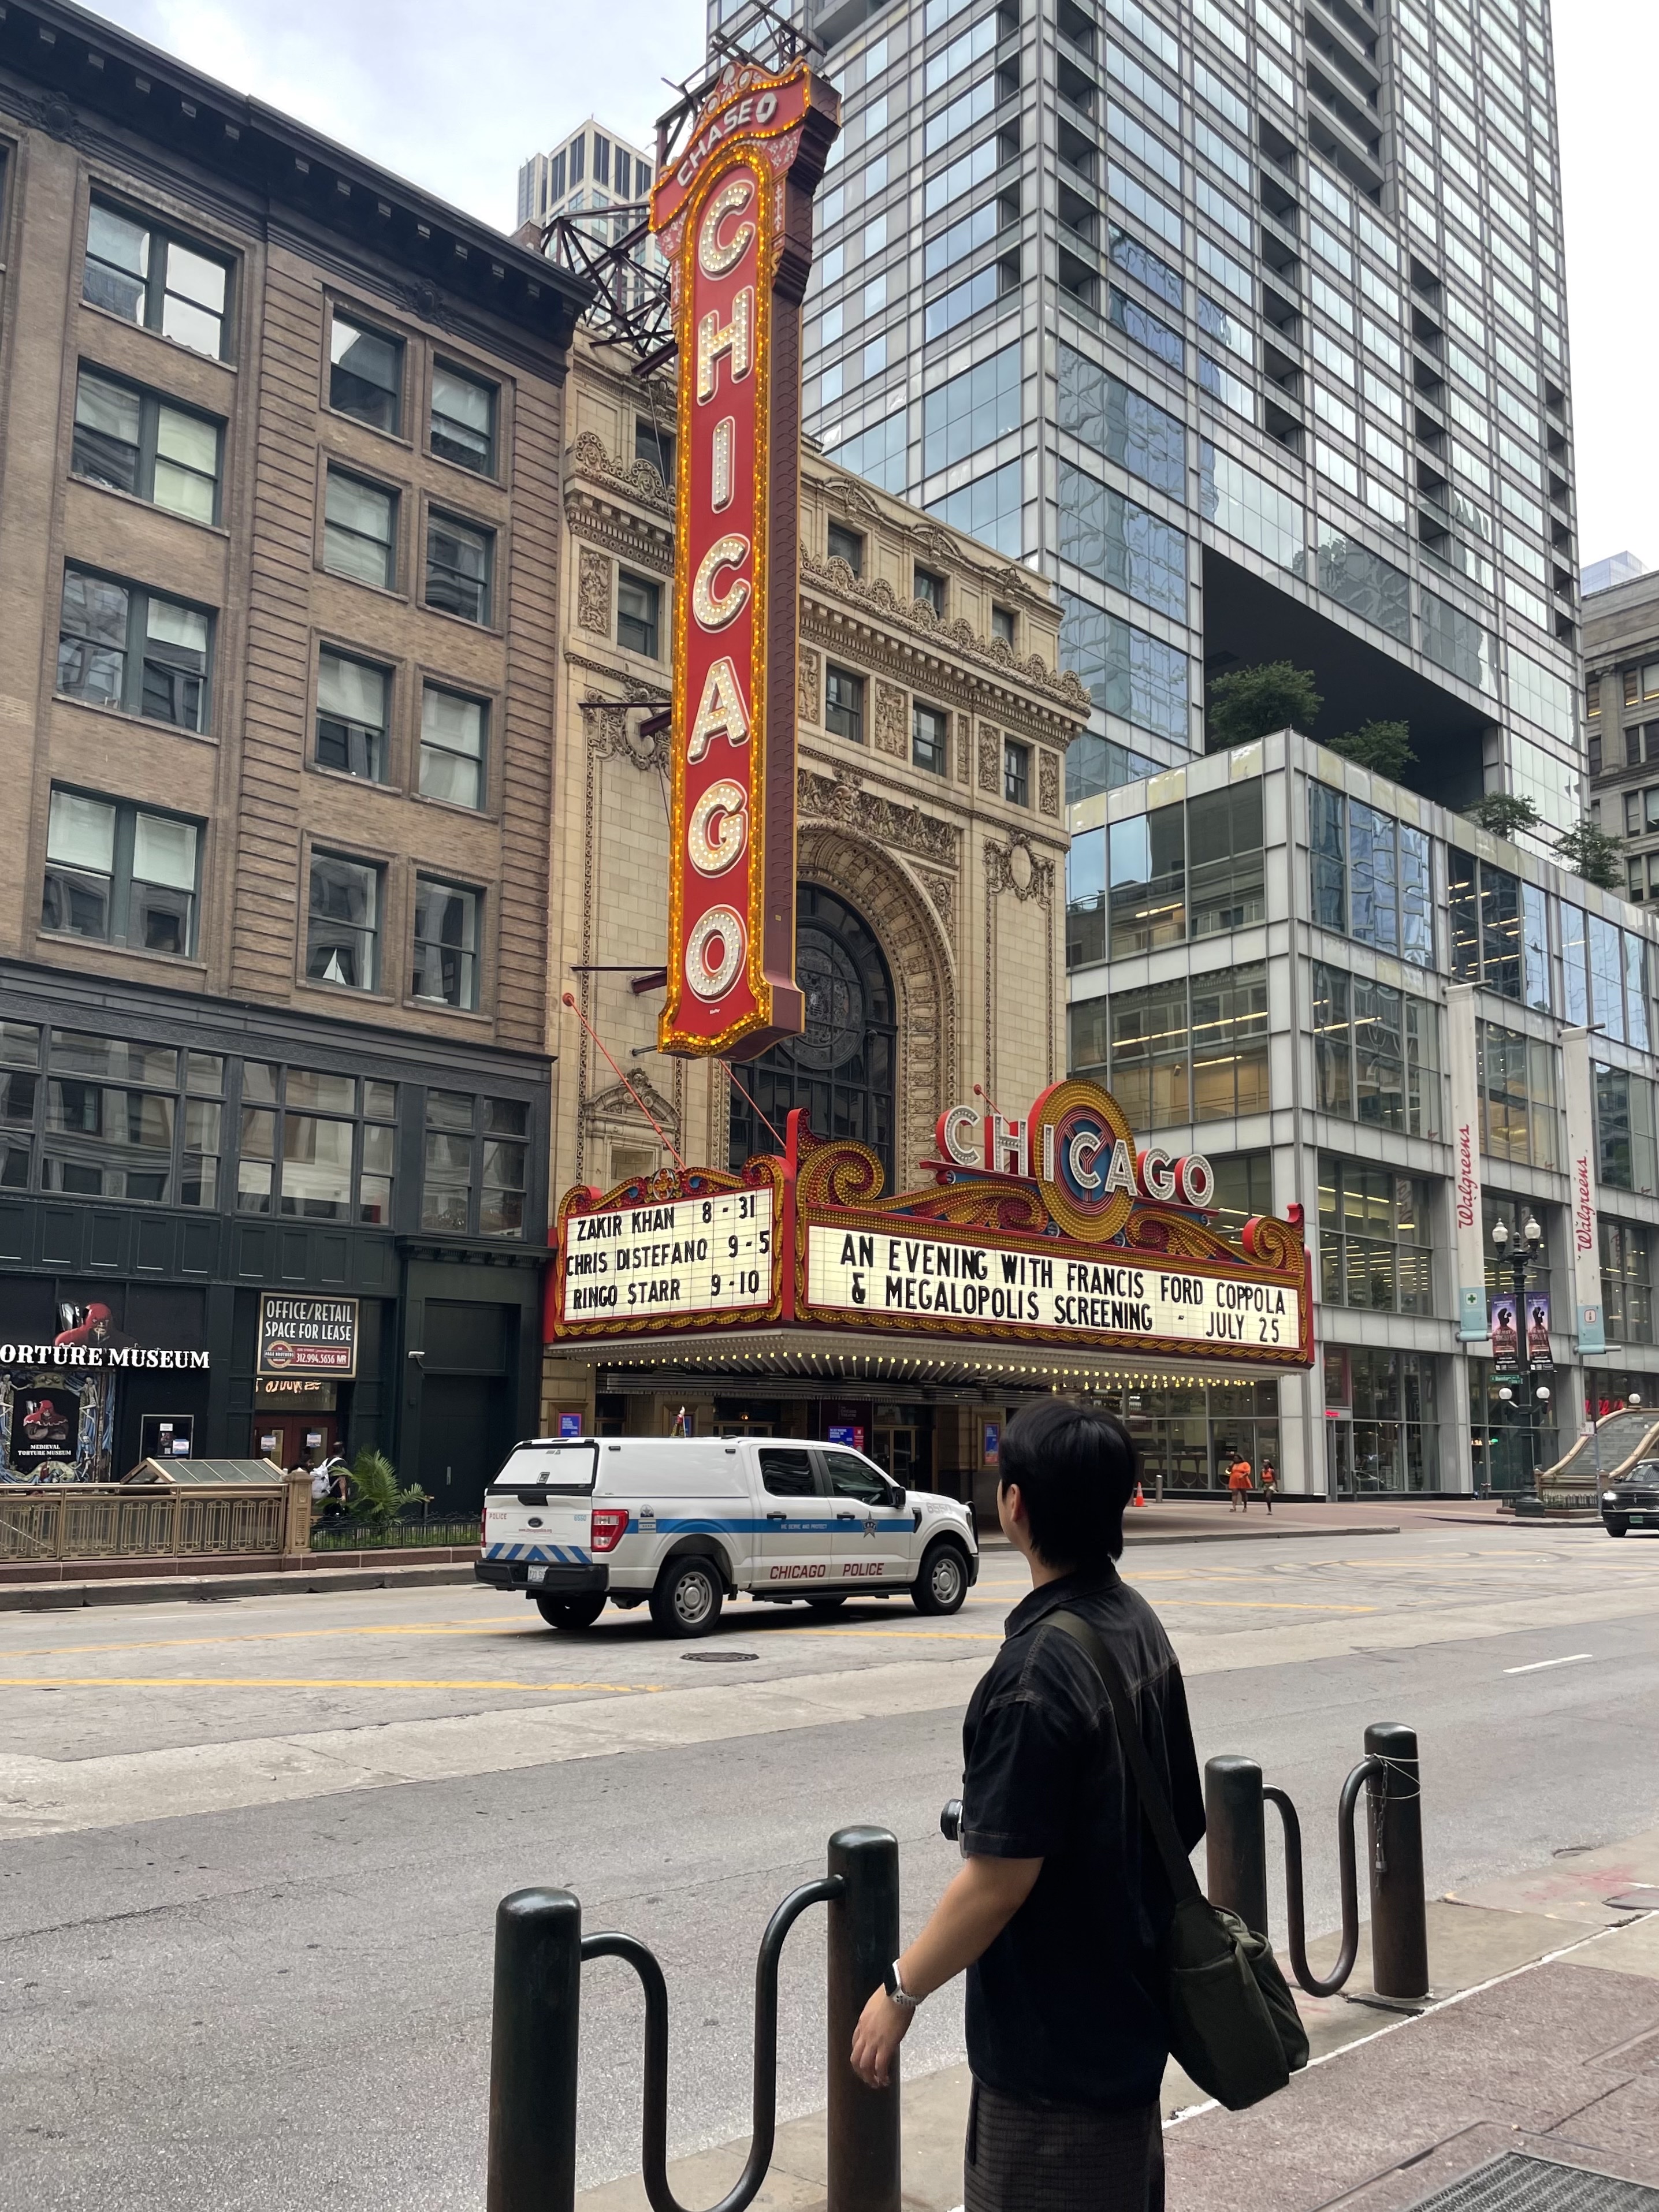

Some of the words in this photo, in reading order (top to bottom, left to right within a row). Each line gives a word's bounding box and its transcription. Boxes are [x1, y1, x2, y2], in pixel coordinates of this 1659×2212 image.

[677, 98, 753, 187] CHASE
[685, 180, 754, 1003] CHICAGO
[942, 1104, 1215, 1207] CHICAGO
[1457, 1124, 1479, 1229] Walgreens
[1576, 1156, 1596, 1252] Walgreens
[577, 1215, 622, 1241] ZAKIR
[632, 1206, 675, 1234] KHAN
[566, 1252, 607, 1276] CHRIS
[617, 1238, 708, 1270] DISTEFANO
[841, 1234, 873, 1267] AN
[889, 1239, 989, 1281] EVENING
[1002, 1254, 1053, 1289] WITH
[1067, 1263, 1144, 1298] FRANCIS
[1161, 1275, 1203, 1305] FORD
[1216, 1283, 1286, 1315] COPPOLA
[266, 1300, 352, 1323] OFFICE/RETAIL
[573, 1285, 618, 1309] RINGO
[628, 1278, 680, 1305] STARR
[851, 1272, 866, 1305] &
[885, 1276, 1040, 1321] MEGALOPOLIS
[1055, 1295, 1152, 1331] SCREENING
[1206, 1312, 1244, 1340] JULY
[1259, 1317, 1280, 1343] 25
[265, 1321, 296, 1338] SPACE
[299, 1323, 318, 1339] FOR
[322, 1324, 352, 1341] LEASE
[107, 1348, 210, 1369] MUSEUM
[296, 1353, 335, 1364] 312.994.5656
[927, 1502, 952, 1515] 6550
[769, 1565, 826, 1580] CHICAGO
[842, 1563, 884, 1577] POLICE
